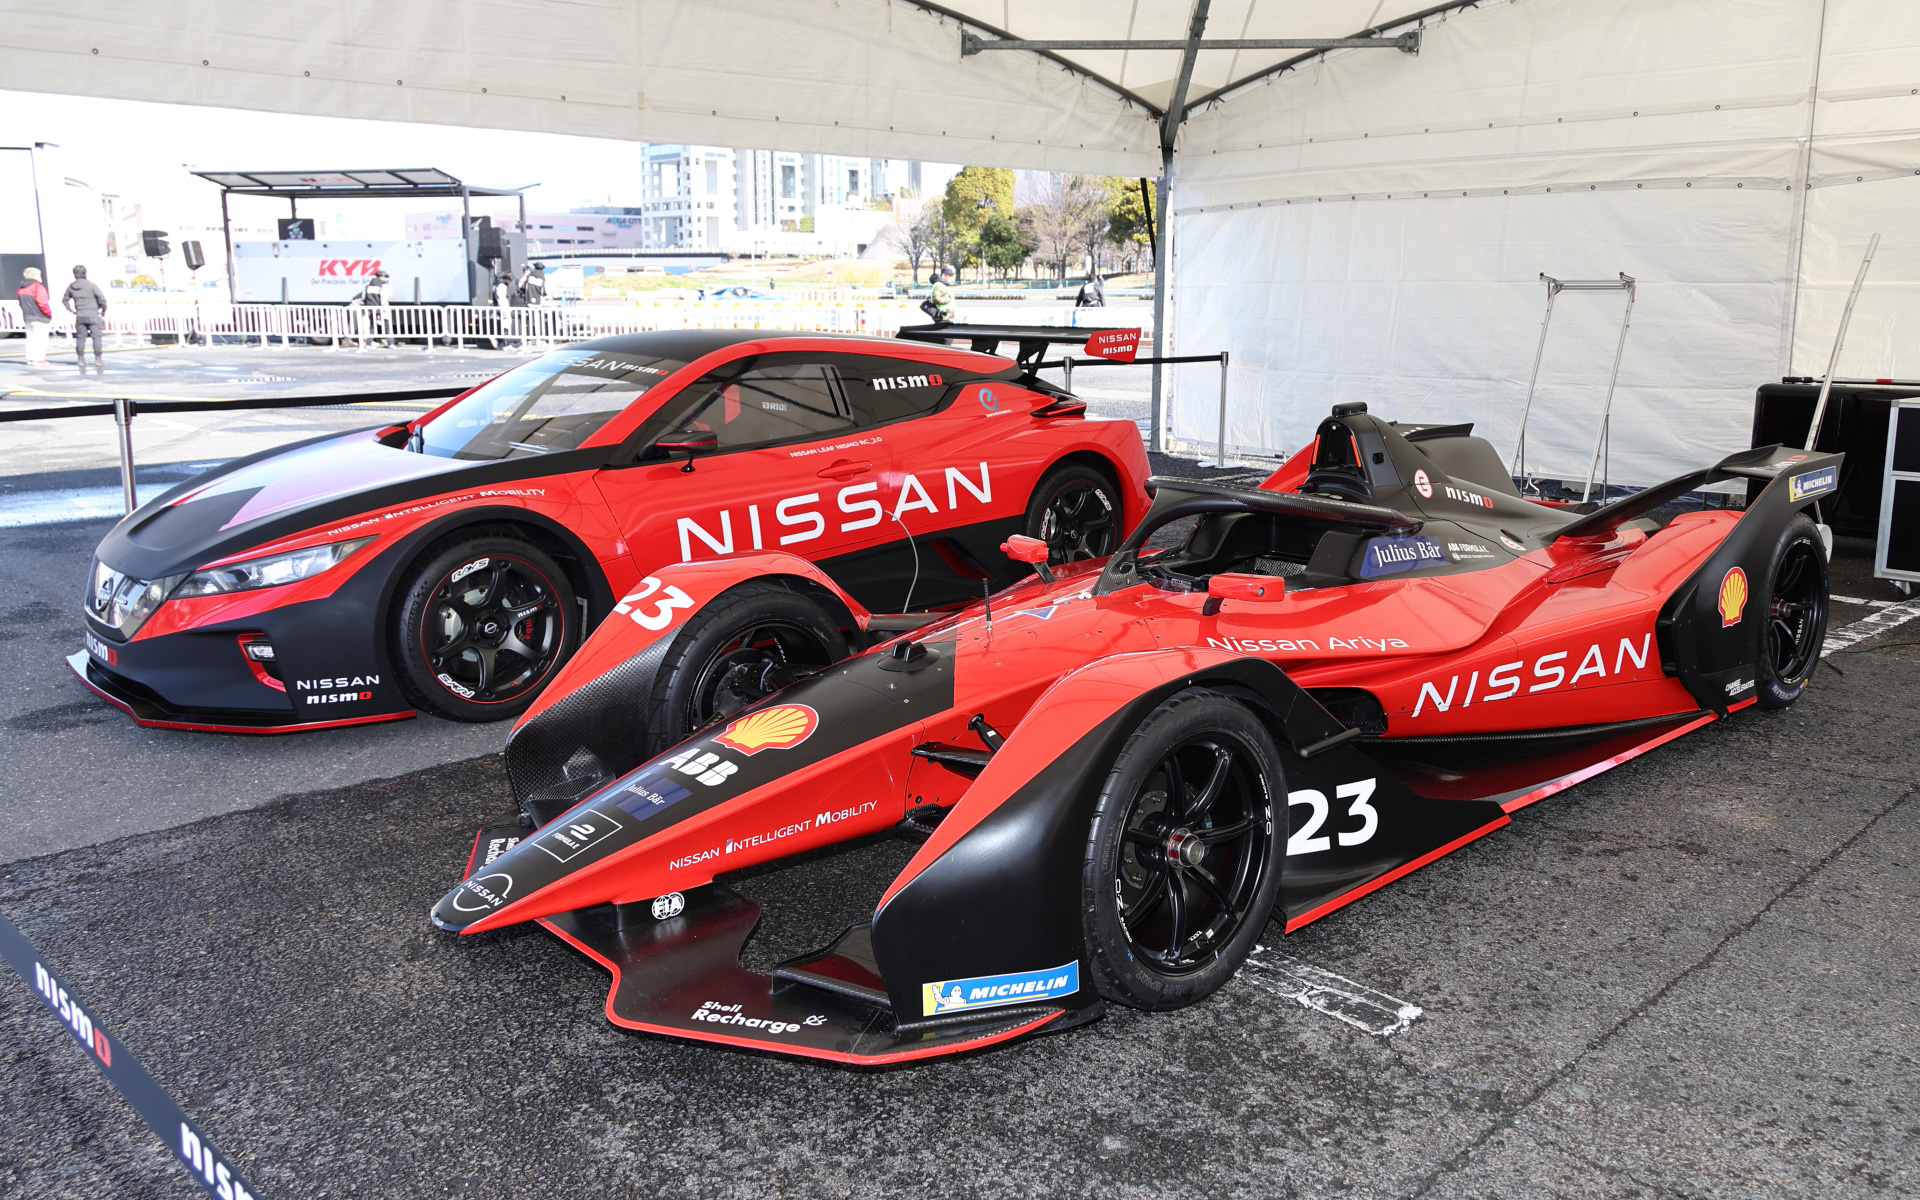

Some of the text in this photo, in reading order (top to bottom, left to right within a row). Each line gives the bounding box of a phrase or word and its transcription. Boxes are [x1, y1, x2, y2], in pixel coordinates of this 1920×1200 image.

[319, 259, 382, 276] KYB
[1098, 332, 1137, 344] NISSAN
[1103, 344, 1133, 355] nismo
[620, 363, 670, 376] nismo
[872, 373, 944, 391] nismo
[762, 401, 788, 412] BRIDE
[789, 448, 818, 458] NISSAN
[818, 445, 835, 454] LEAF
[835, 441, 859, 450] NISMO
[1803, 474, 1833, 491] MICHELIN
[1445, 485, 1494, 509] nismo
[327, 488, 546, 536] NISSAN INTELLIGENT MOBILITY
[677, 461, 993, 563] NISSAN
[1374, 541, 1442, 568] Julius Bär
[452, 557, 490, 583] RAYS
[518, 604, 543, 618] nismo
[612, 576, 696, 631] 23
[85, 630, 119, 667] nismo
[1206, 634, 1409, 653] Nissan Ariya
[296, 674, 380, 690] NISSAN
[1411, 632, 1651, 719] NISSAN
[306, 691, 373, 704] nismo
[658, 747, 739, 787] ABB
[624, 783, 666, 806] Julius Bär
[1286, 777, 1379, 857] 23
[551, 832, 575, 848] FORMULA
[669, 799, 878, 871] NISSAN INTELLIGENT MOBILITY
[464, 880, 504, 908] NISSAN
[969, 974, 1069, 1001] MICHELIN
[35, 960, 112, 1068] nismo
[701, 1000, 743, 1013] Shell
[690, 1008, 801, 1035] Recharge
